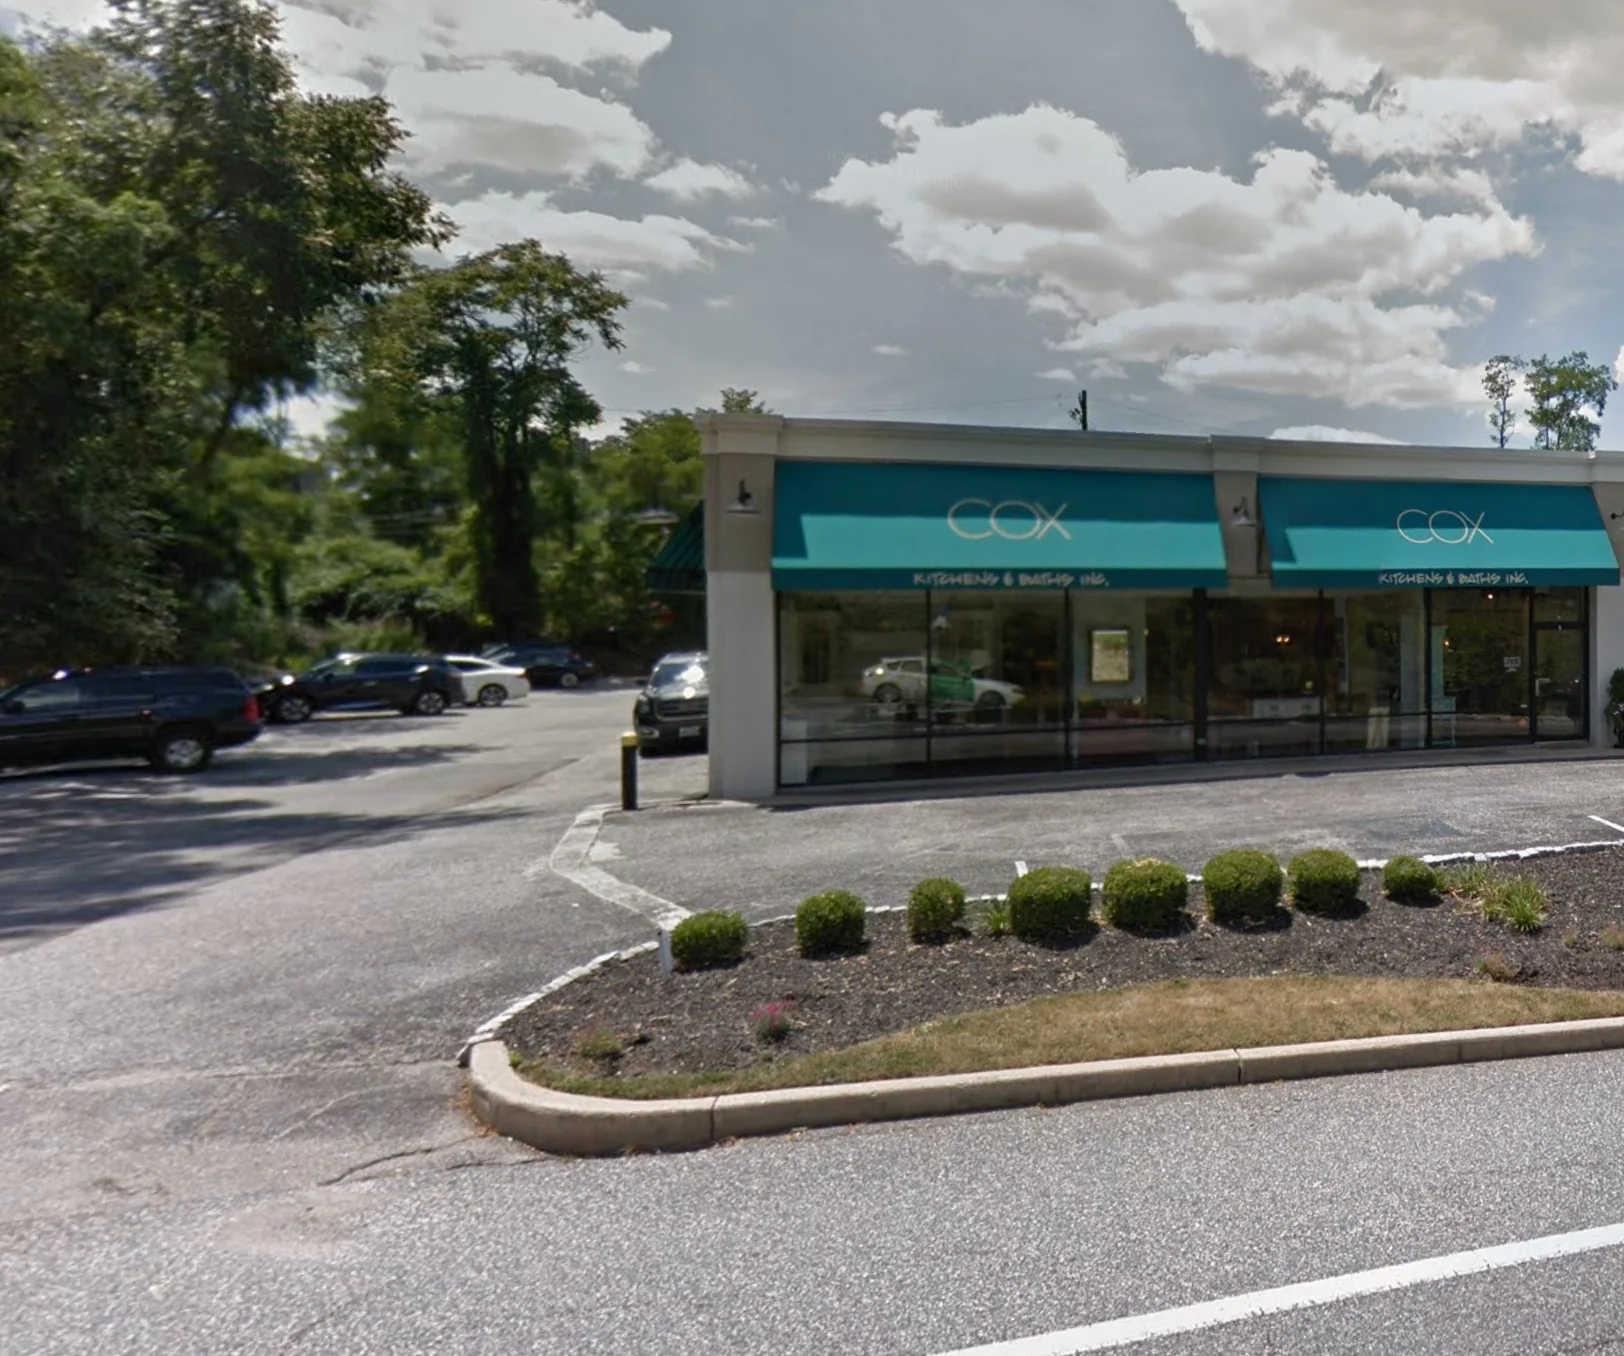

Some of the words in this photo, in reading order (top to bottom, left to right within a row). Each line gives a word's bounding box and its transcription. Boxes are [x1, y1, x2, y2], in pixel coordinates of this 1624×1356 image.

[947, 498, 1072, 540] COX
[1397, 508, 1494, 544] COX
[1379, 572, 1443, 585] KITCHENS
[1458, 573, 1500, 585] BATHS
